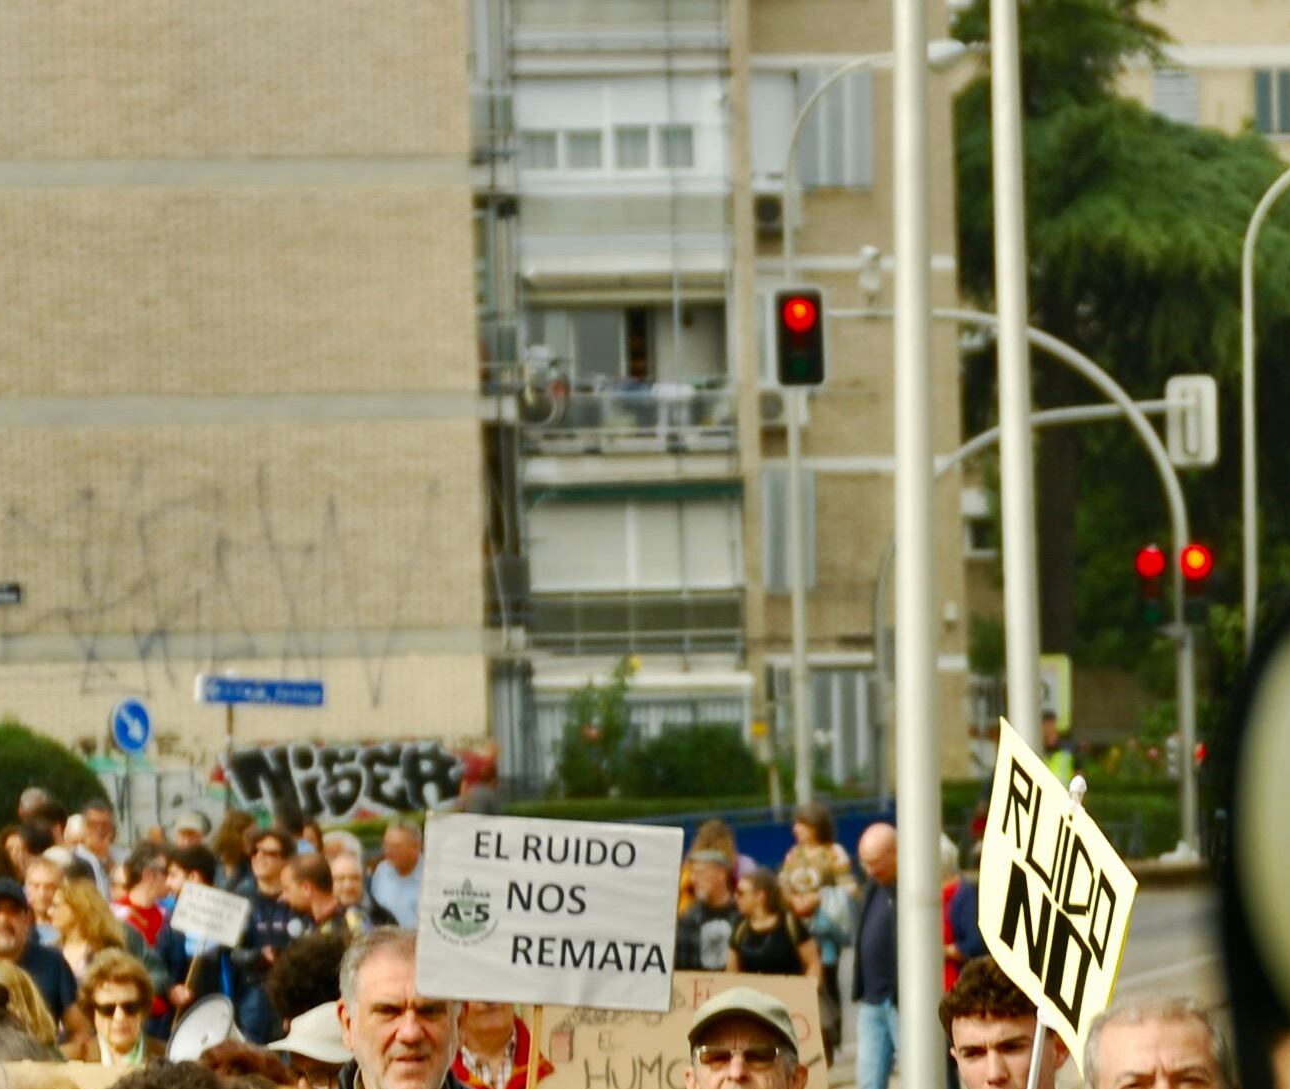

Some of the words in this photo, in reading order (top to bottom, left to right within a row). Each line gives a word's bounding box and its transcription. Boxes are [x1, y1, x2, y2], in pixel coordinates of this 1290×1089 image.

[473, 831, 510, 861] EL
[521, 834, 637, 869] RUIDO
[440, 901, 491, 924] A-5
[506, 880, 587, 916] NOS
[510, 934, 668, 975] REMATA
[999, 860, 1093, 1034] NO
